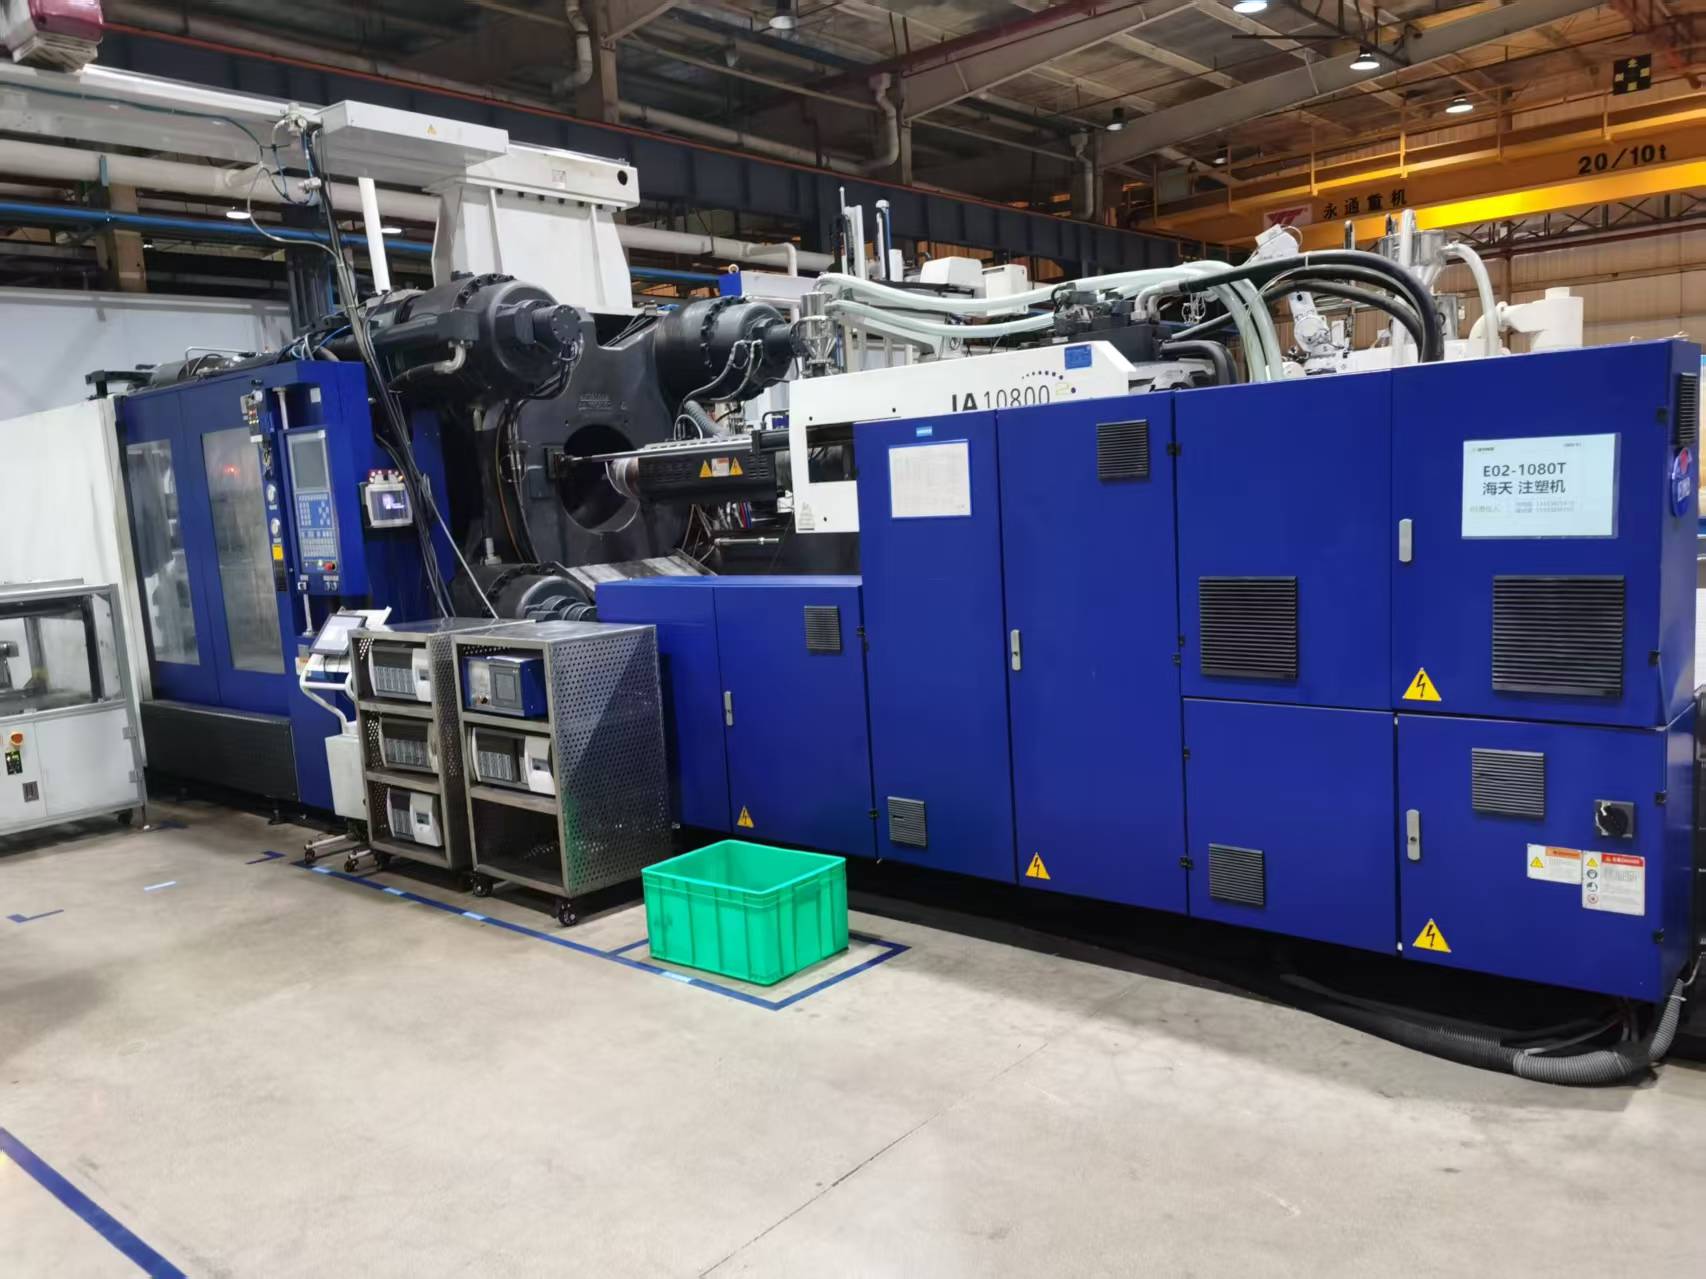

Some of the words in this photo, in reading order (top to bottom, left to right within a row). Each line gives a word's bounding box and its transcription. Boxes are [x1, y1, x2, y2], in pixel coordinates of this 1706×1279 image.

[1578, 144, 1666, 176] 20/10t
[1323, 188, 1407, 220] 永通重机
[1483, 462, 1567, 478] E02-1080T
[1482, 481, 1513, 496] 海天
[1518, 479, 1567, 495] 注塑机
